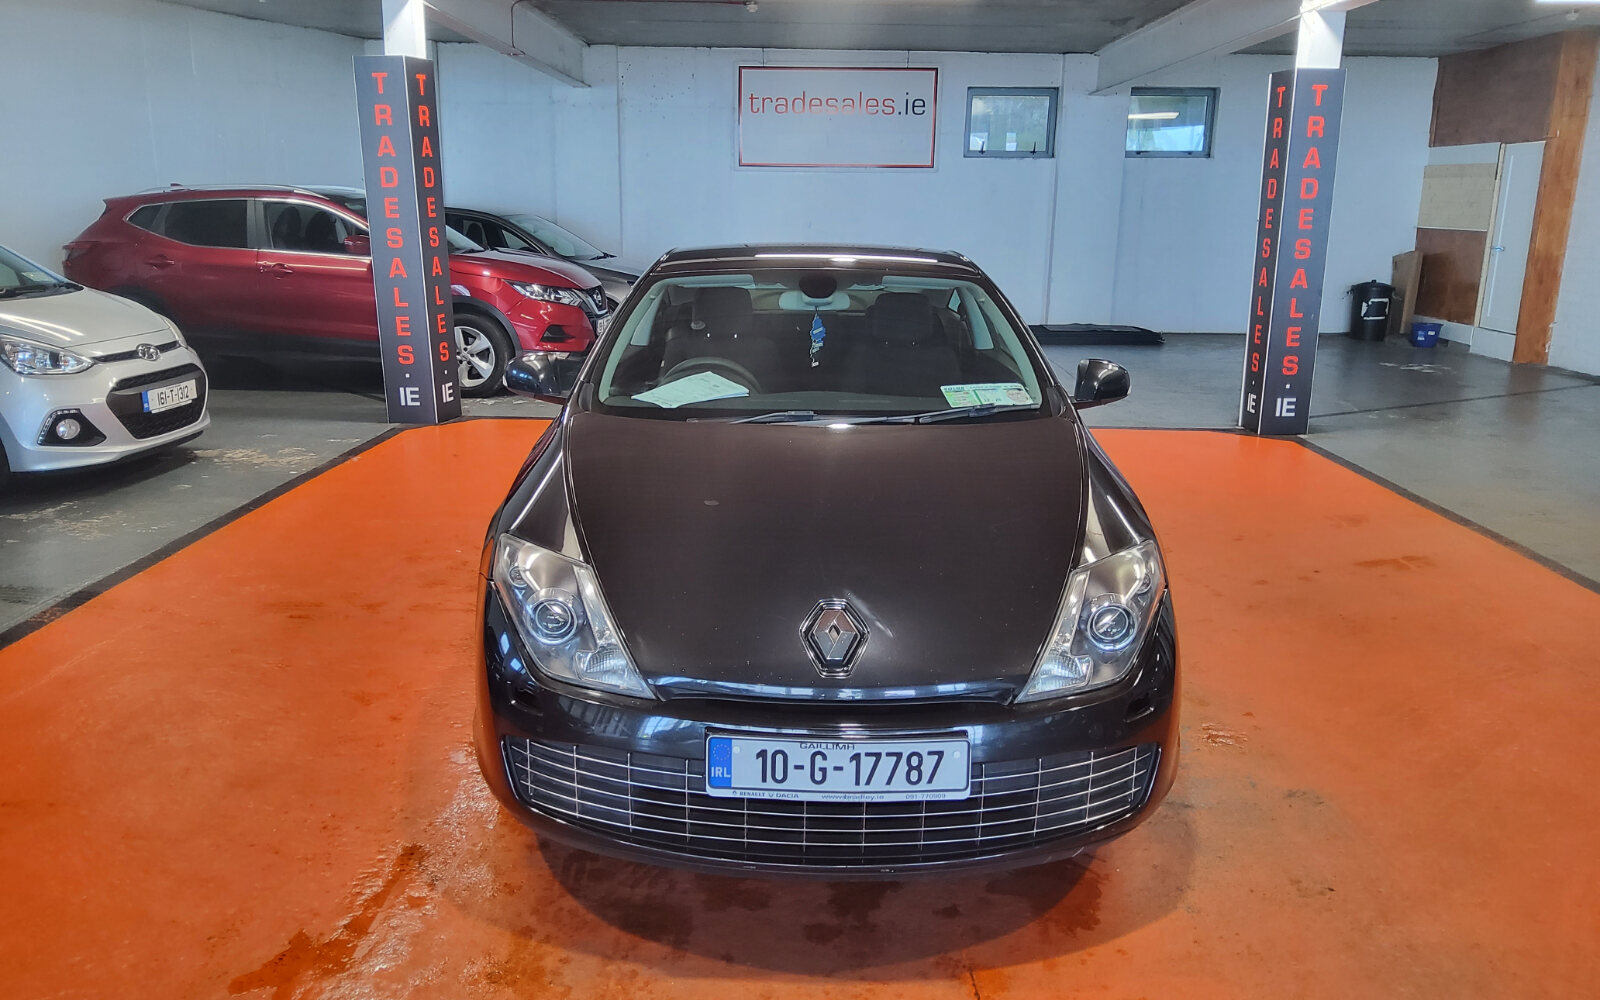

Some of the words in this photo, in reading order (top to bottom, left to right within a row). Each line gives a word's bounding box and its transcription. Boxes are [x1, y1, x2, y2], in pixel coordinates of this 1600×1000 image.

[749, 91, 926, 116] tradesales.ie
[799, 742, 855, 750] GAILLIMH
[711, 766, 731, 778] IRL
[755, 749, 945, 786] 10-G-17787
